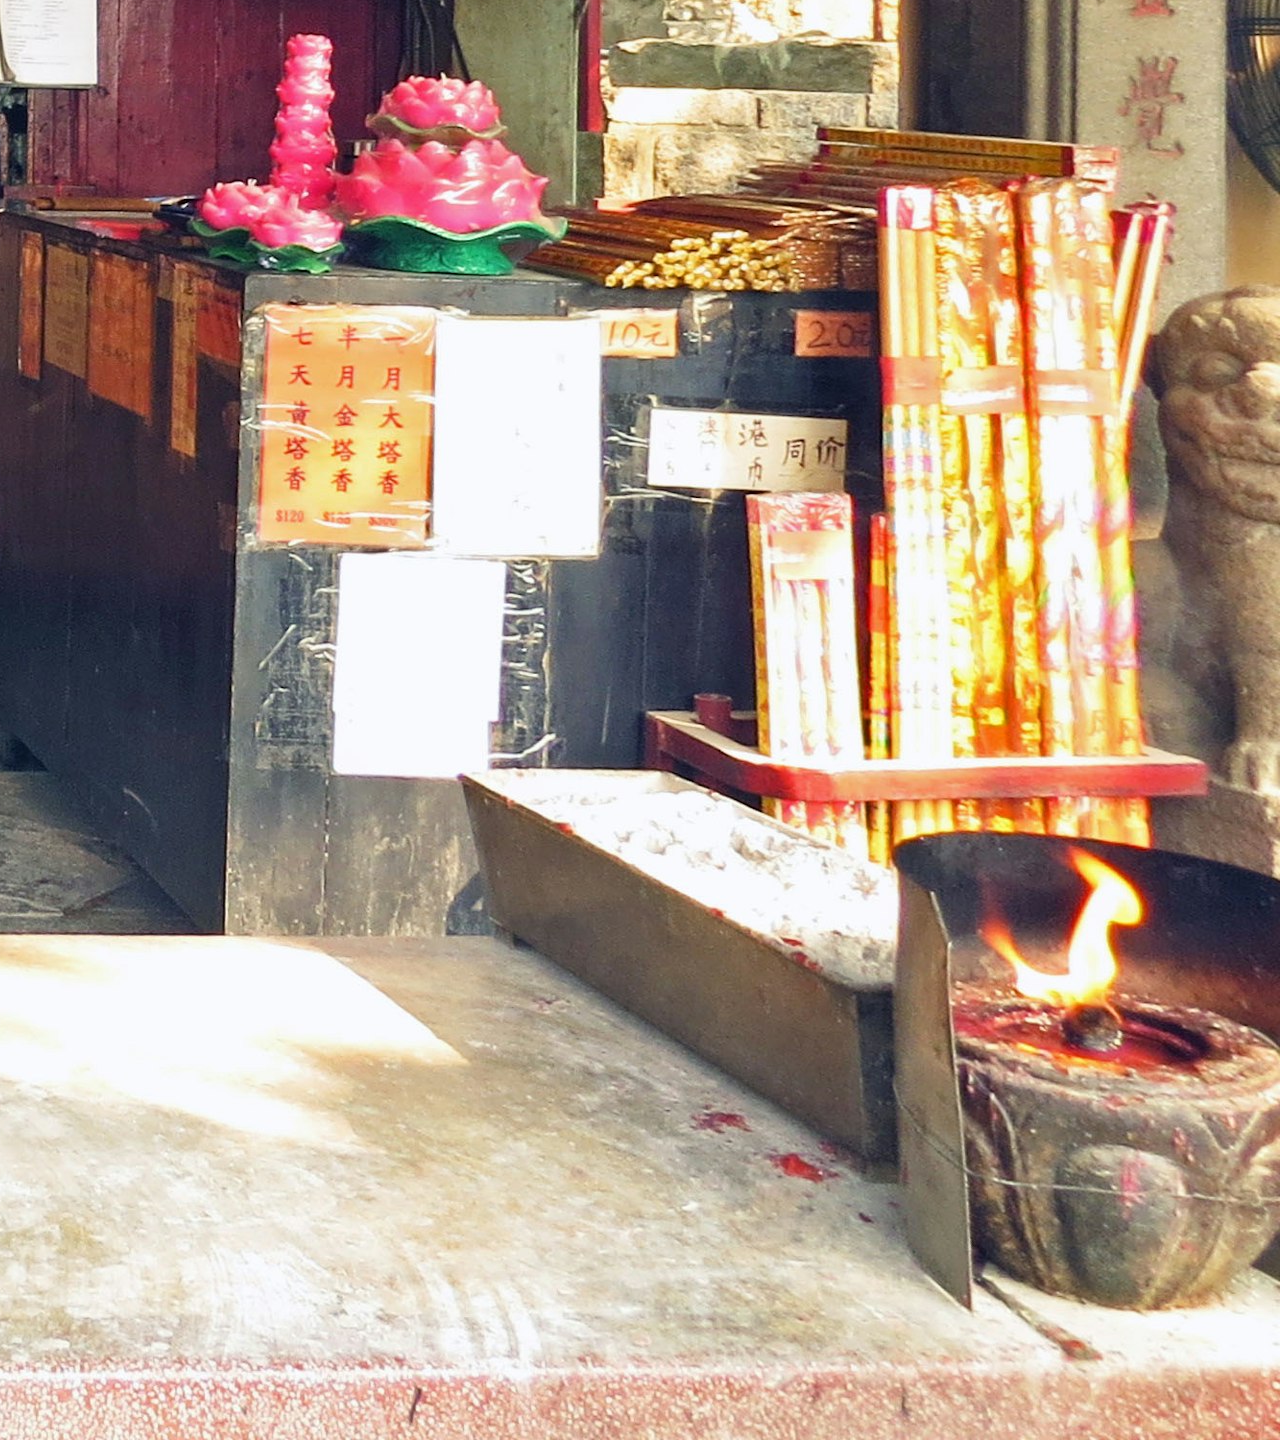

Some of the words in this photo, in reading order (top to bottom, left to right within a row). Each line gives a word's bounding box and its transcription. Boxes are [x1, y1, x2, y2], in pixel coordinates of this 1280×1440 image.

[606, 320, 671, 350] 10元
[330, 325, 360, 494] 半月金塔香
[375, 335, 408, 497] 一月大塔香
[738, 419, 770, 487] 港币
[781, 436, 848, 471] 同价
[275, 509, 305, 524] $120
